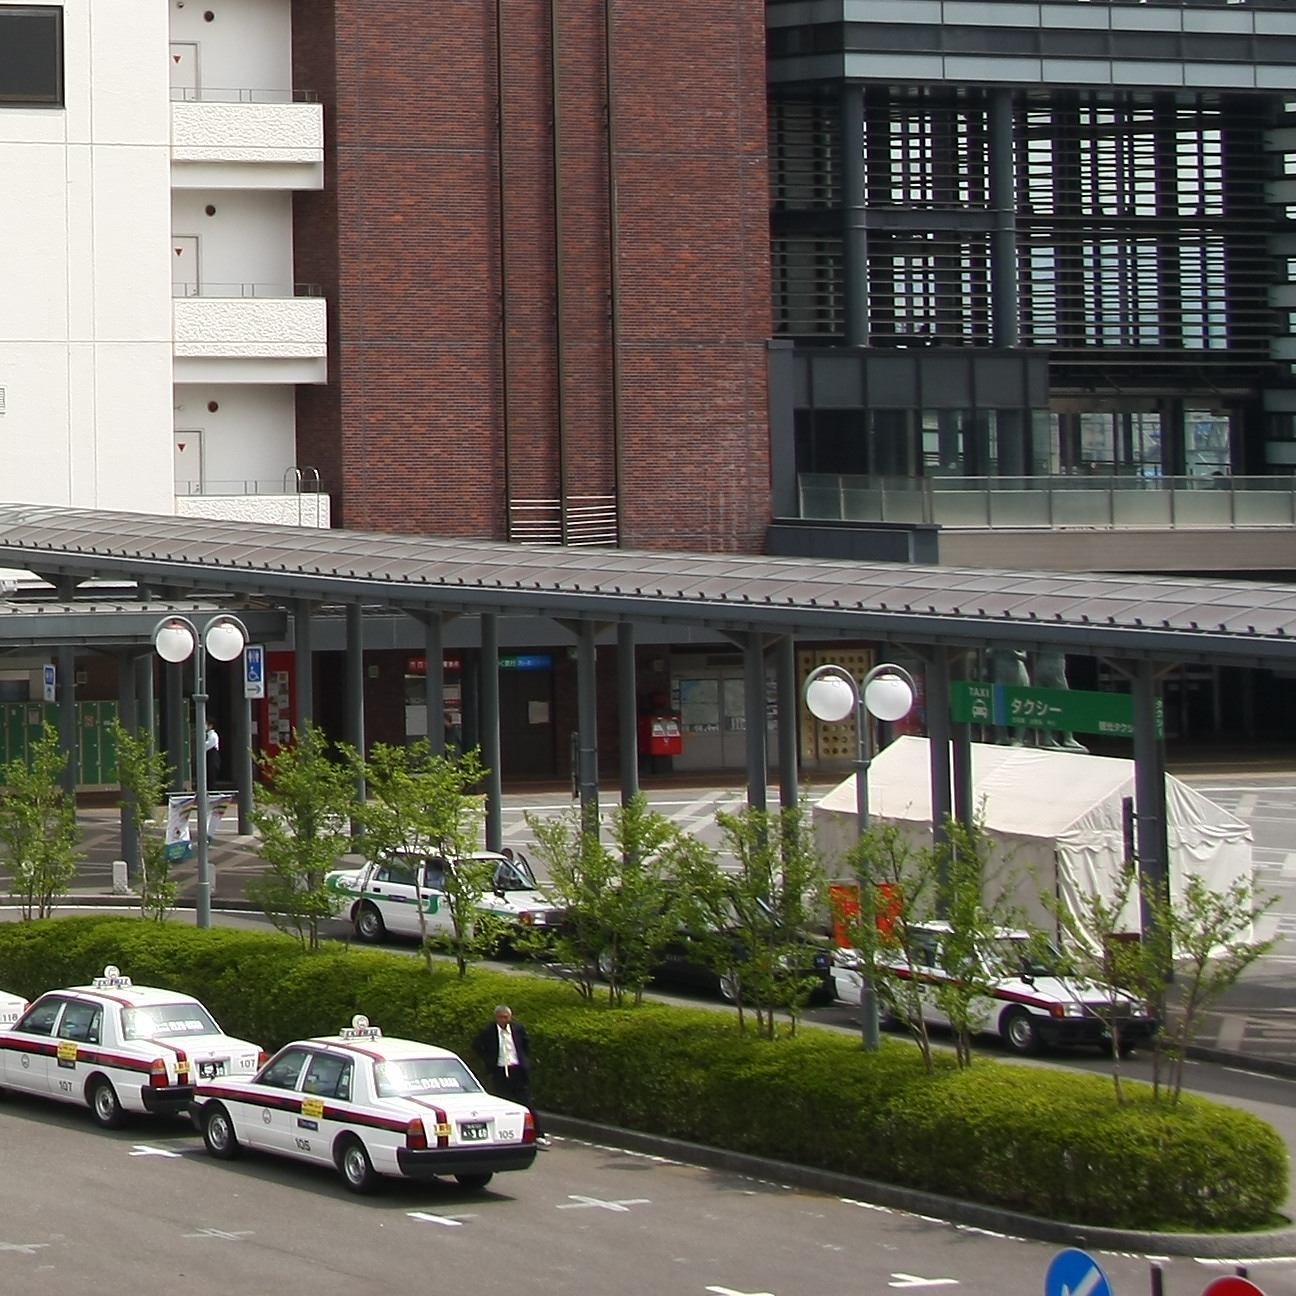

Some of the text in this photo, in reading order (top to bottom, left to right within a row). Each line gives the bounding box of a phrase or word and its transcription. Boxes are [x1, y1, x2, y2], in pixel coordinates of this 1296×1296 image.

[968, 687, 990, 698] TAXI
[1010, 698, 1063, 716] タクシー
[239, 1058, 256, 1069] 107
[58, 1079, 73, 1093] 107
[497, 1129, 516, 1140] 105
[295, 1137, 312, 1152] 105
